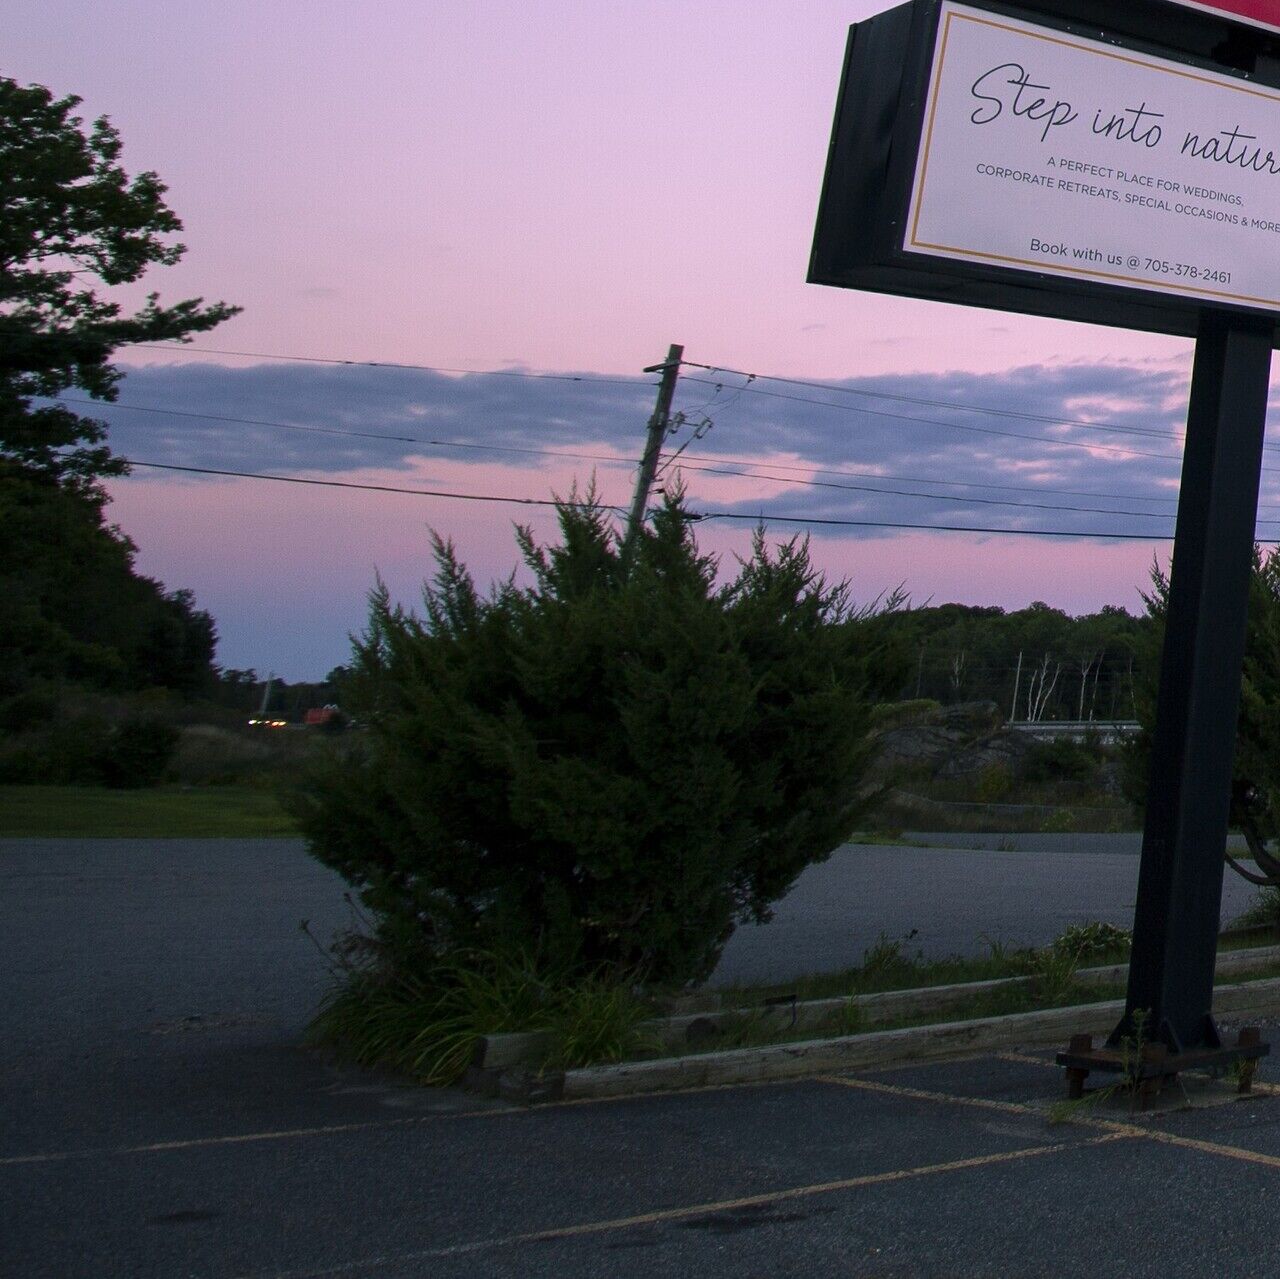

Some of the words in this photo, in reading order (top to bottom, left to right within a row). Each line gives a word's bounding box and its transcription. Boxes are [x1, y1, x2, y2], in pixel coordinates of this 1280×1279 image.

[970, 63, 1078, 142] Step
[1092, 102, 1164, 148] into
[976, 163, 1054, 188] CORPORATE
[1058, 179, 1122, 202] RETREATS,
[1125, 193, 1172, 212] SPECIAL
[1175, 203, 1239, 226] OCCASIONS
[1241, 216, 1248, 227] &
[1047, 156, 1056, 167] A
[1059, 158, 1114, 179] PERFECT
[1116, 170, 1154, 188] PLACE
[1157, 179, 1180, 193] FOR
[1030, 238, 1068, 258] Book
[1072, 246, 1103, 263] with
[1107, 254, 1123, 266] us
[1126, 255, 1141, 270] @
[1144, 258, 1232, 285] 705-378-2461
